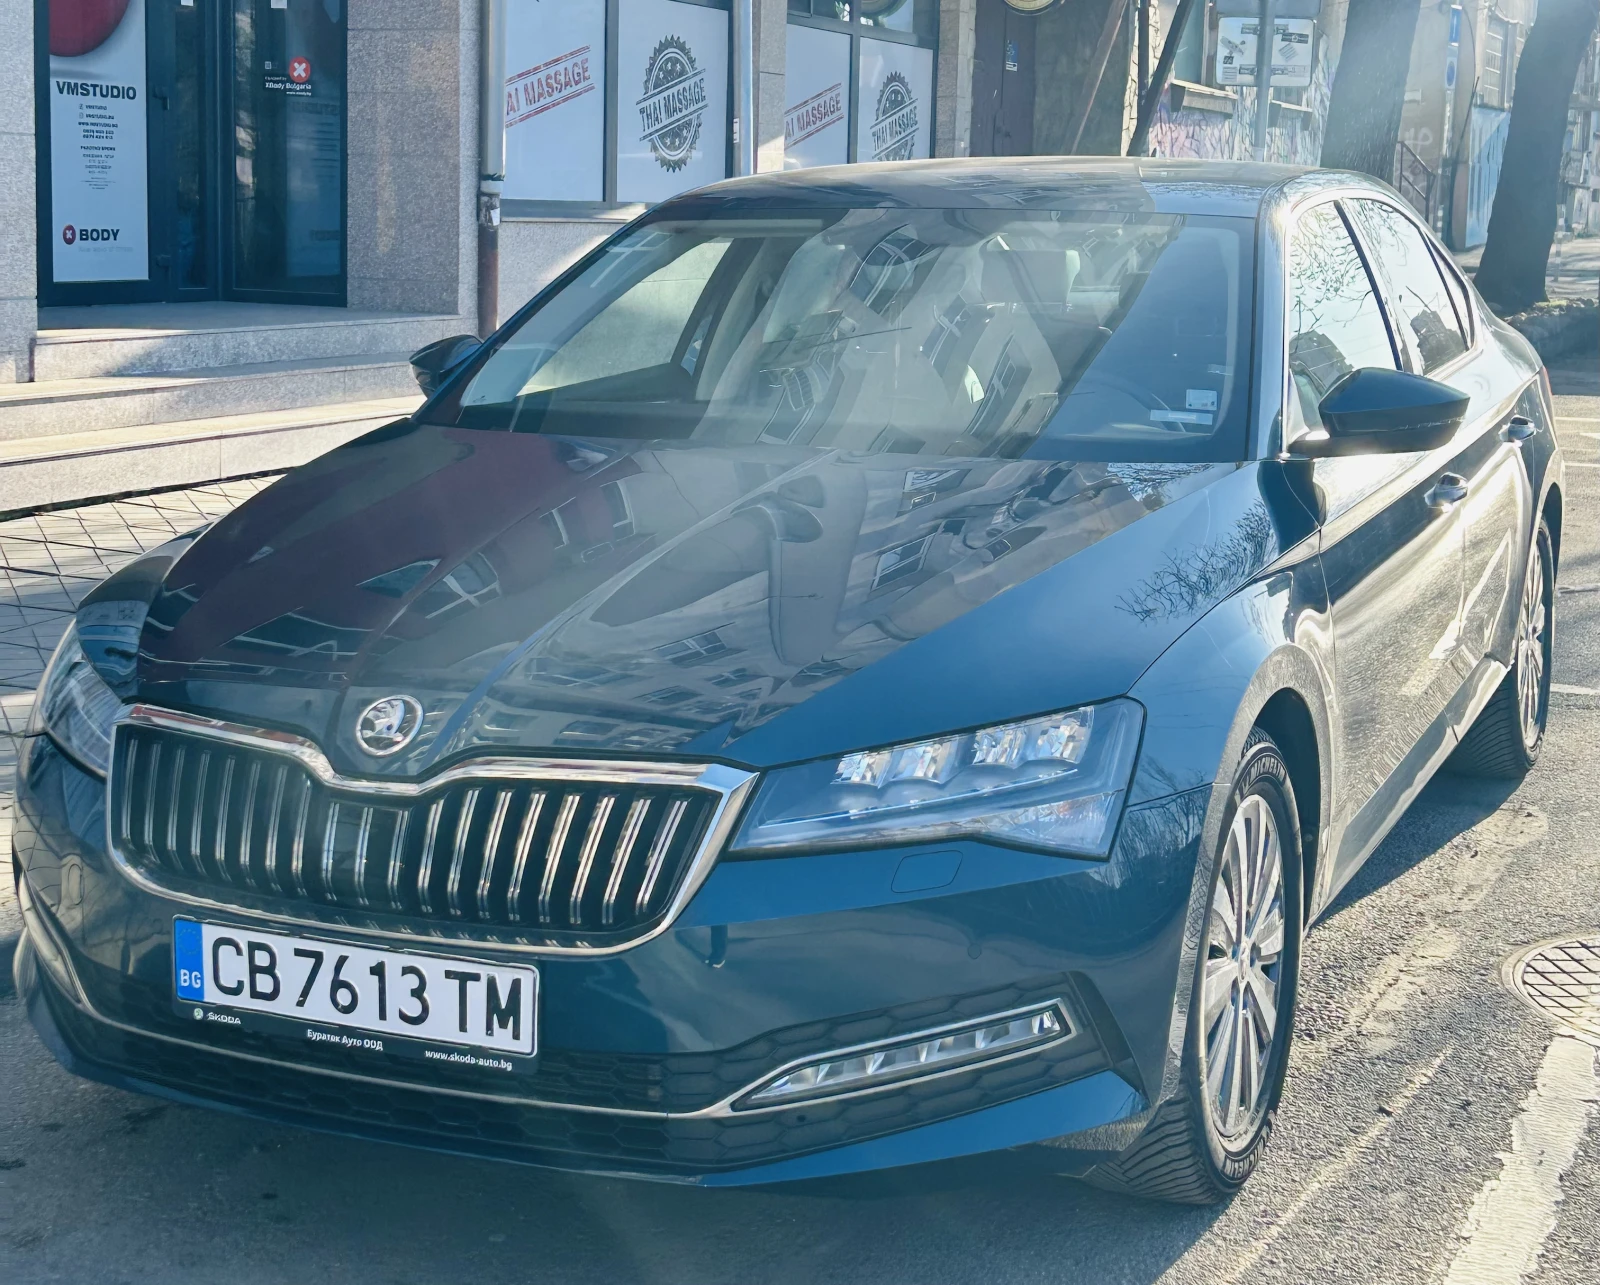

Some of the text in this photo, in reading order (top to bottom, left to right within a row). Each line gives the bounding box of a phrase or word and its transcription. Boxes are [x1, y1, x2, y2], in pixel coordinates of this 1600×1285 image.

[56, 80, 137, 100] VMSTUDIO
[286, 82, 312, 91] Bulgaria
[506, 57, 591, 116] AI MASSAGE
[639, 77, 707, 132] THAI MASSAGE
[797, 92, 842, 133] MASSAGE
[872, 105, 919, 152] THAI MASSAGE
[79, 228, 120, 241] BODY
[1250, 756, 1286, 782] MICHELIN
[179, 969, 202, 988] BG
[212, 936, 522, 1041] CB 7613 TM
[363, 1039, 383, 1051] ООД
[425, 1050, 513, 1071] www.skoda-auto.bg
